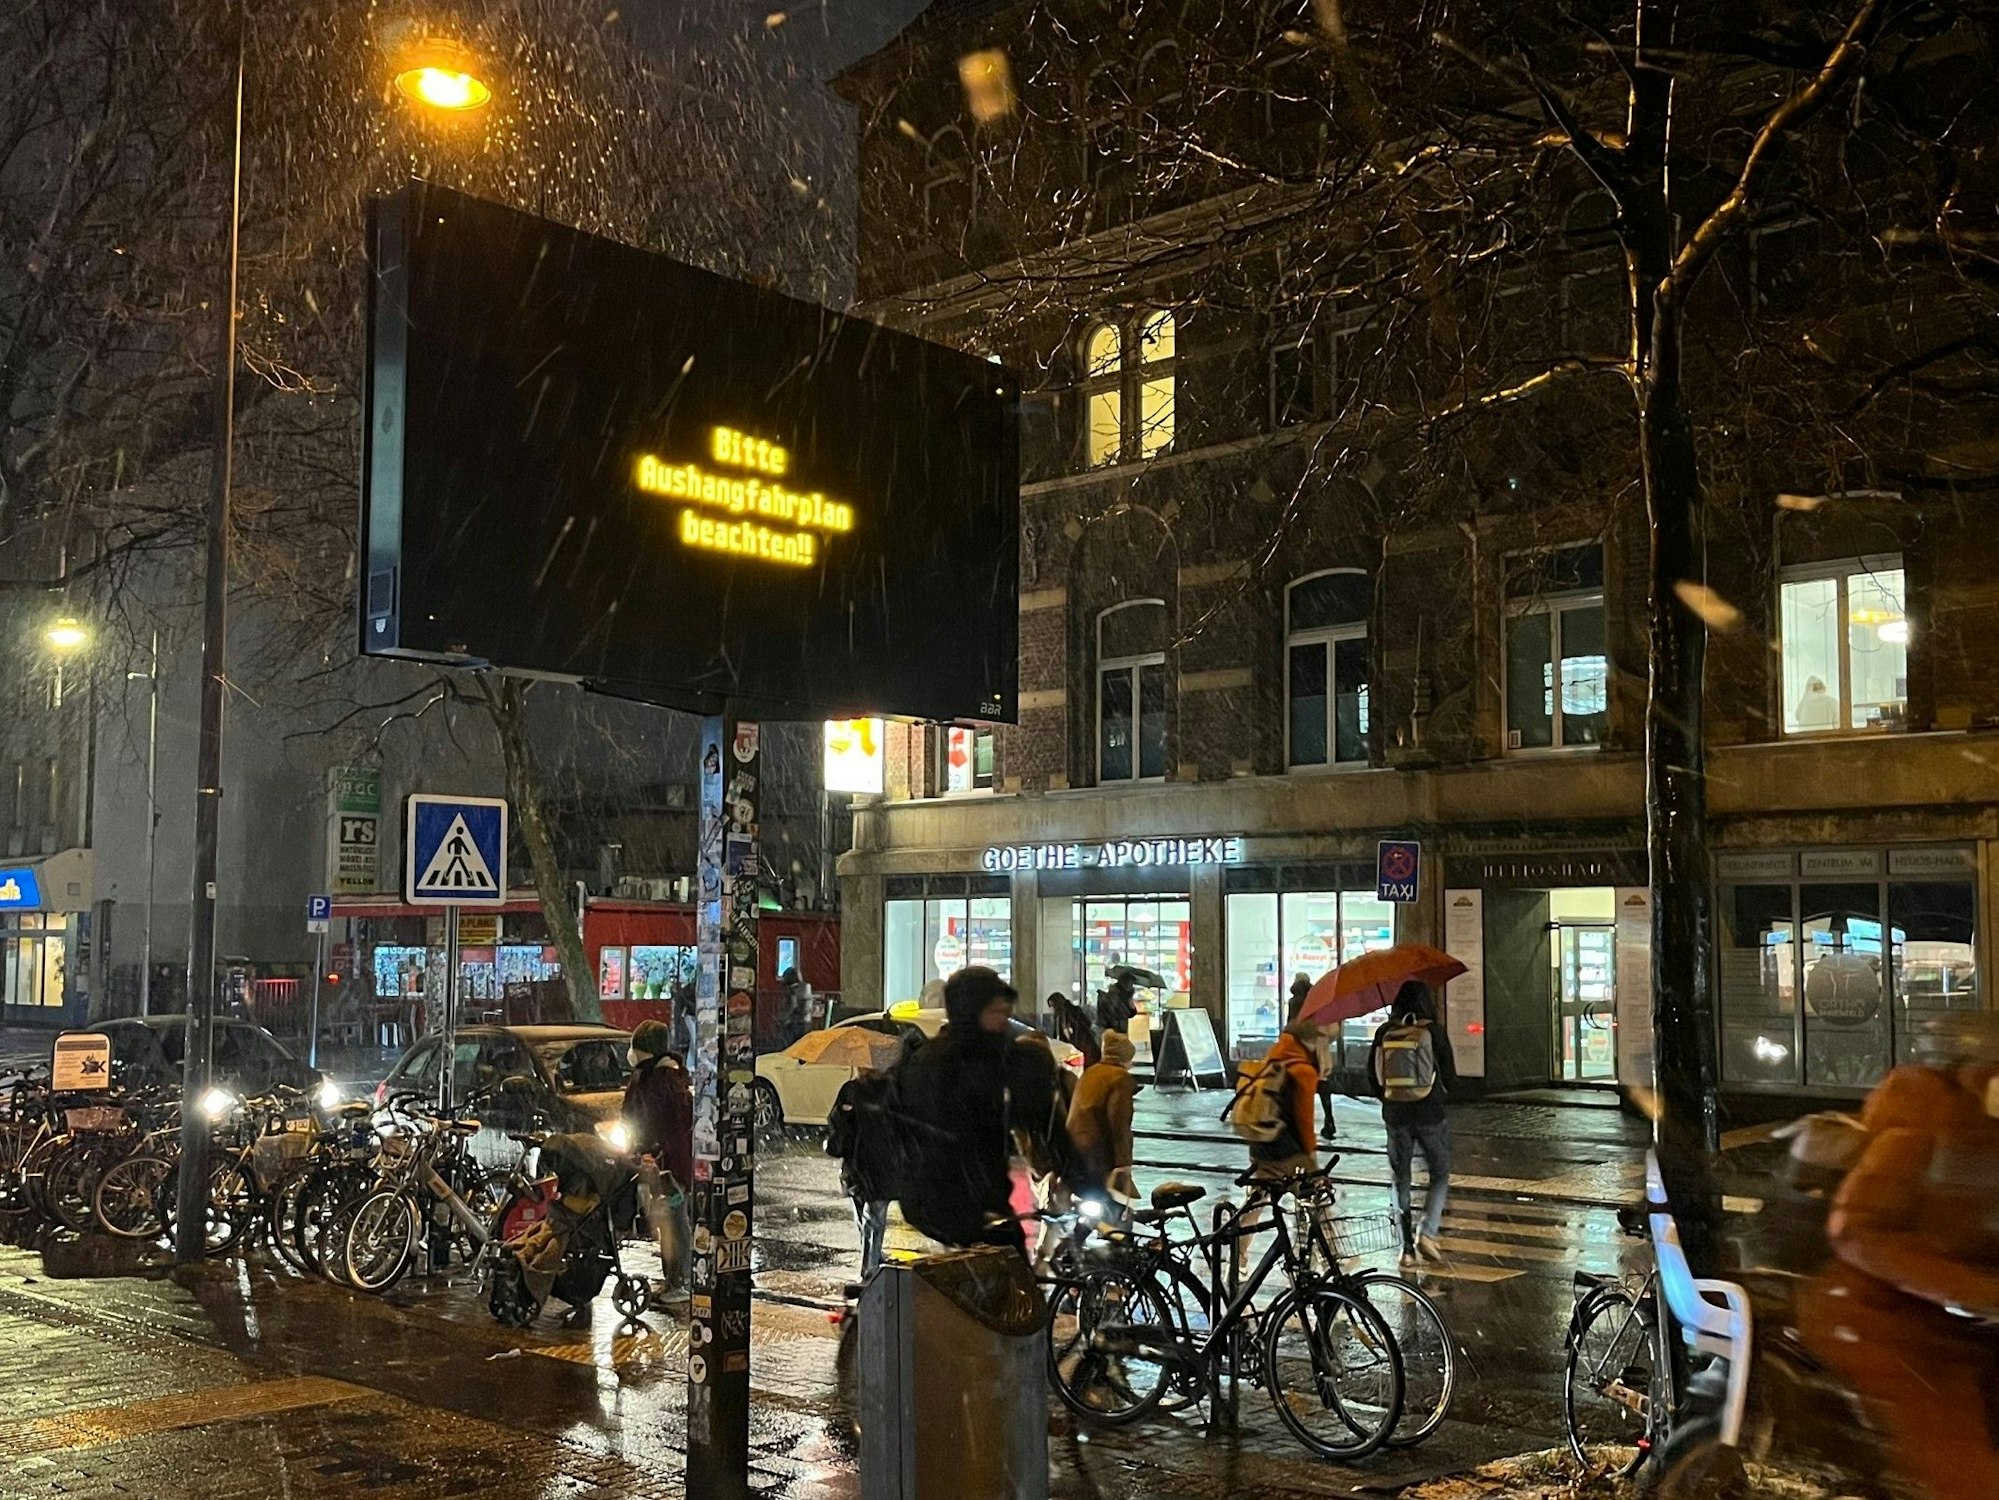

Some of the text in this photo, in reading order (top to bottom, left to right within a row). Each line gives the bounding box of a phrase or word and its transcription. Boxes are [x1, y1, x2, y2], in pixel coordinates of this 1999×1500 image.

[712, 425, 787, 475] Bitte
[637, 454, 853, 532] Aushangfahrplan
[680, 508, 815, 567] beachten!!
[343, 819, 375, 843] rs
[339, 877, 375, 886] YELLOW
[1381, 882, 1414, 898] TAXI
[312, 897, 326, 917] P
[1818, 998, 1866, 1011] ORTHO
